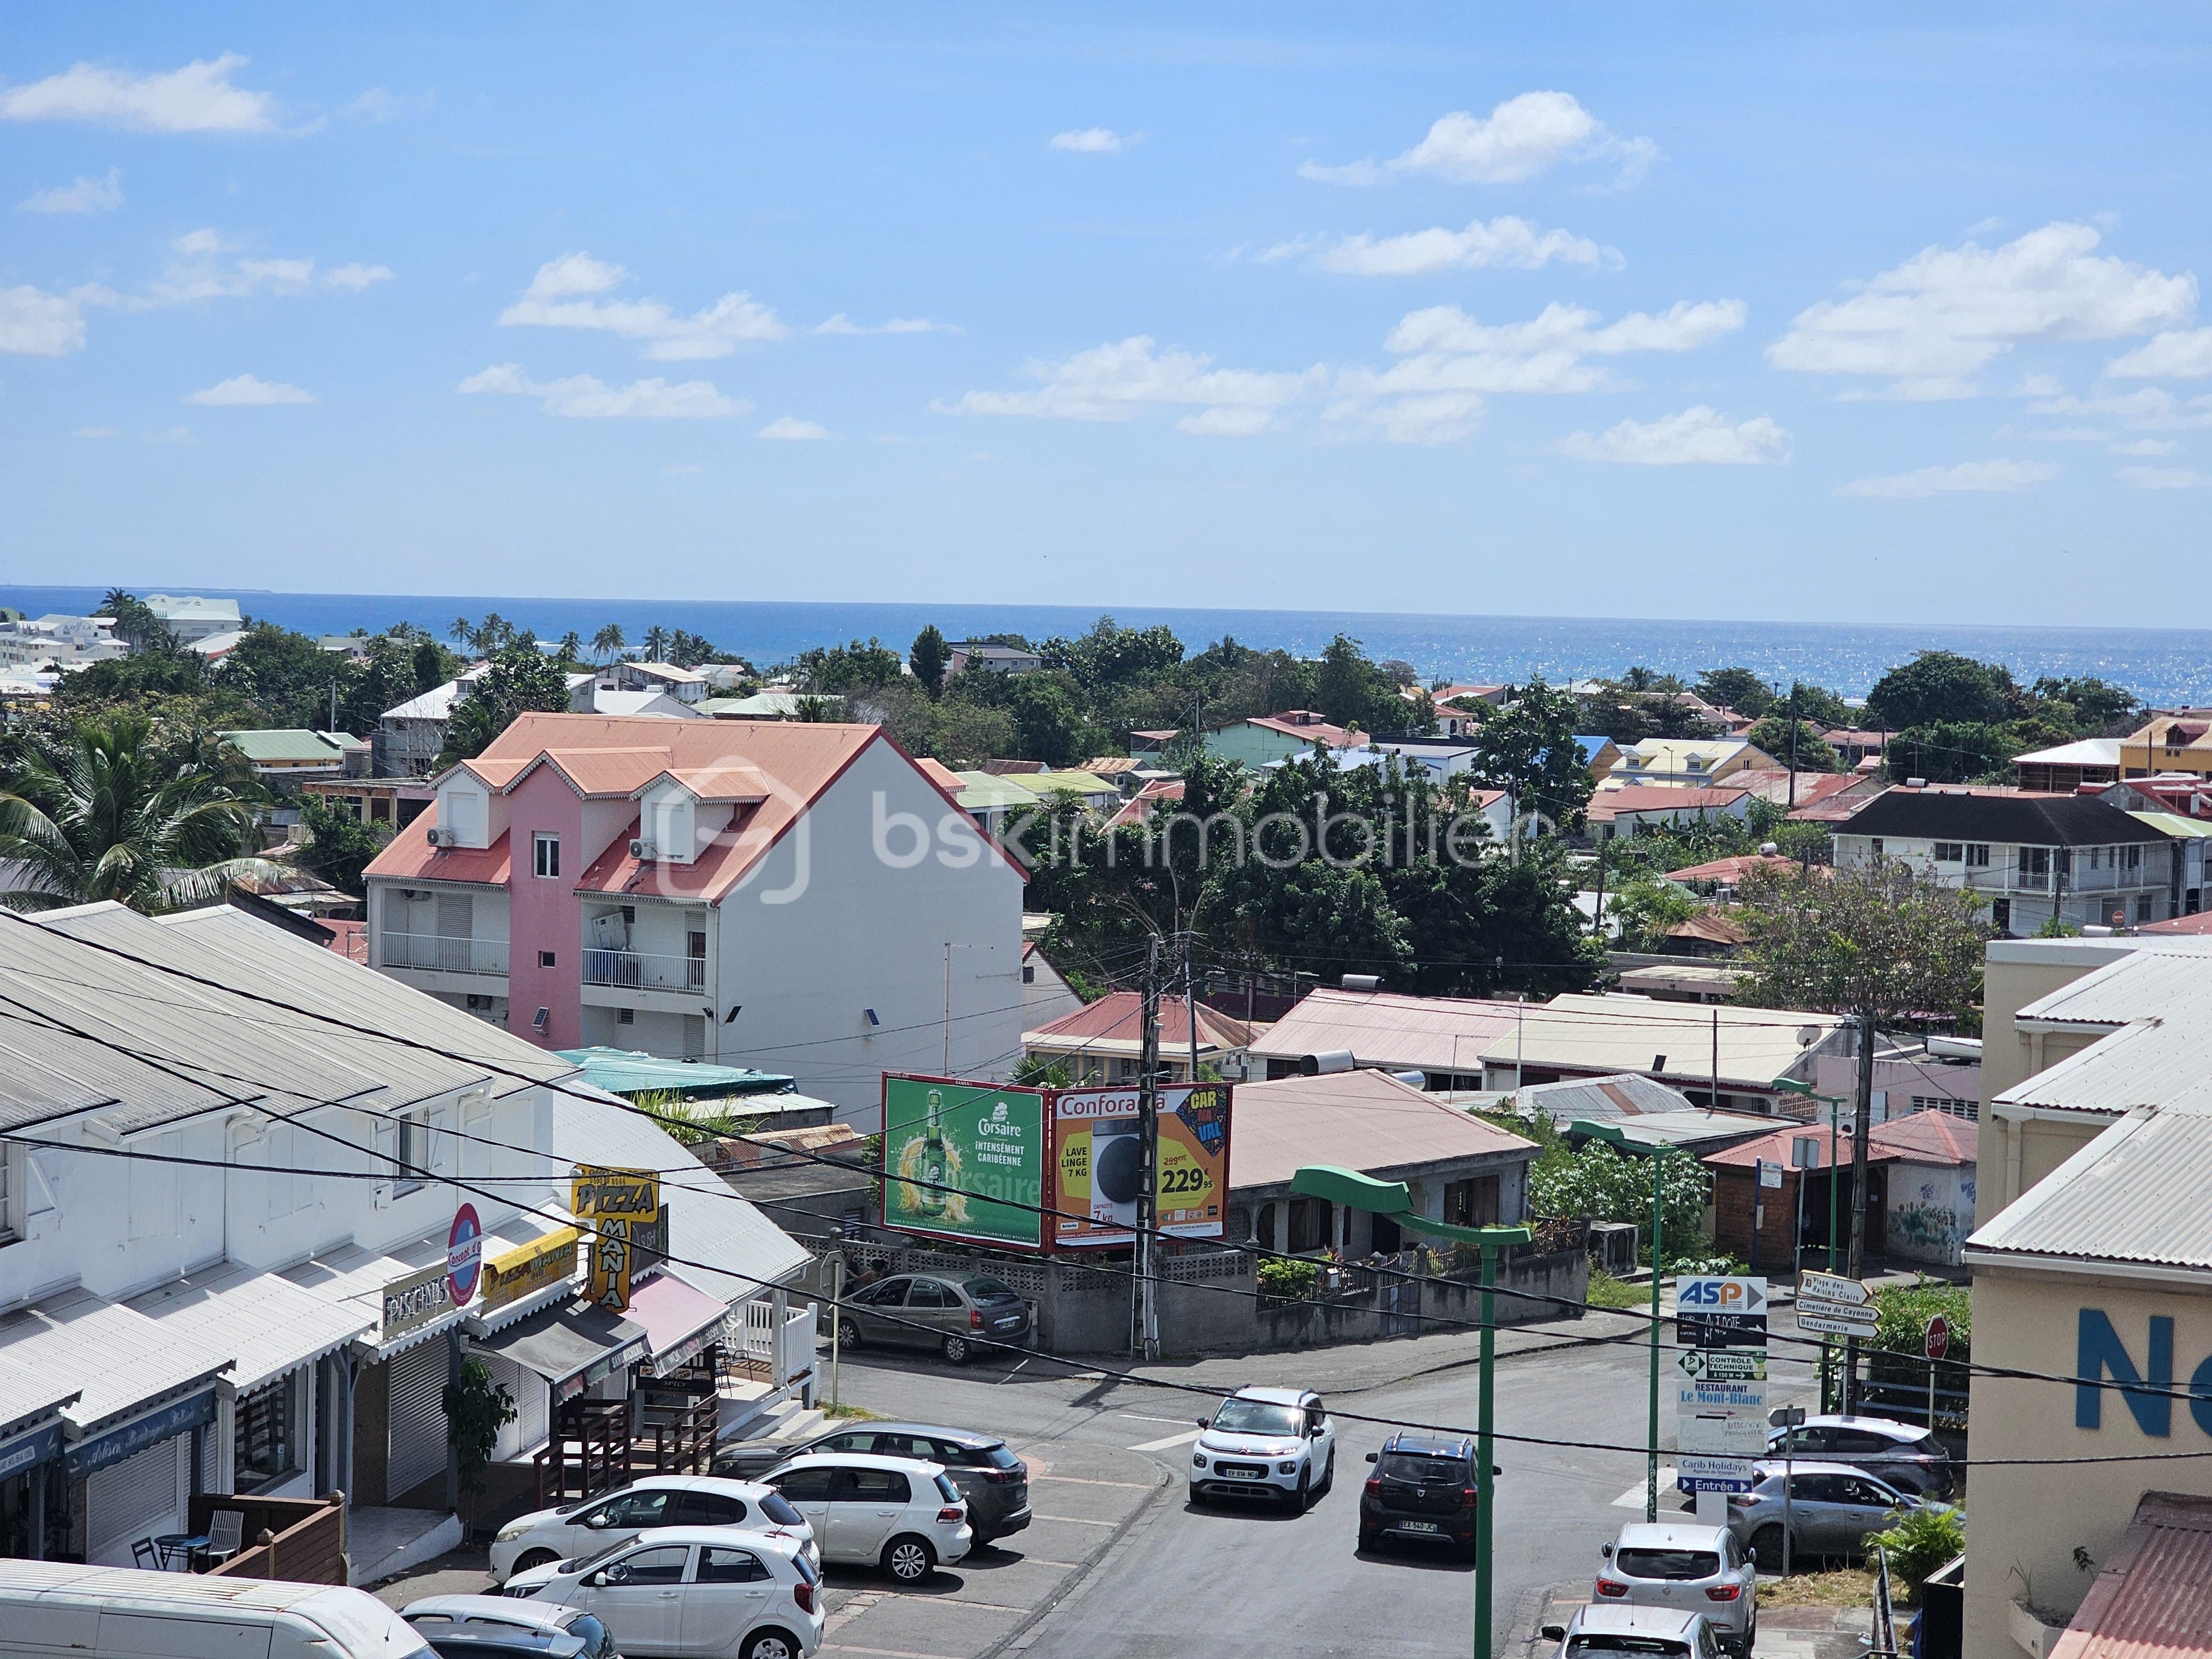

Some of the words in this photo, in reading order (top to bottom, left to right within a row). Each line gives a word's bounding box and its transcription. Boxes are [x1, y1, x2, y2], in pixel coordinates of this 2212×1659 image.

[1062, 1095, 1165, 1115] Conforaa
[1191, 1091, 1217, 1109] CAR
[978, 1118, 1021, 1137] Corsaire
[1198, 1121, 1222, 1141] VAL
[975, 1141, 1025, 1155] INTENSÉMENT
[1066, 1147, 1087, 1156] LAVE
[978, 1152, 1022, 1166] CARIBÉENNE
[1061, 1158, 1087, 1168] LINGE
[1068, 1169, 1073, 1177] 7
[1076, 1168, 1087, 1177] KG
[1161, 1168, 1203, 1193] 229
[576, 1182, 655, 1215] PIZZA
[1094, 1211, 1101, 1220] 7
[448, 1249, 470, 1264] Concept
[472, 1241, 482, 1253] d'O
[530, 1242, 573, 1272] MANIA
[598, 1218, 627, 1309] MANIA
[1813, 1277, 1829, 1287] Plage
[1833, 1281, 1844, 1290] des
[384, 1275, 451, 1327] PISCINES
[1680, 1281, 1742, 1305] ASP
[1812, 1287, 1835, 1297] Raisins
[1839, 1291, 1859, 1301] Clairs
[1799, 1301, 1832, 1312] Cimetière
[1843, 1307, 1873, 1318] Cayenne
[1801, 1318, 1848, 1332] Gendarmerie
[1929, 1332, 1945, 1349] STOP
[1695, 1384, 1748, 1393] RESTAURANT
[1681, 1390, 1694, 1402] Le
[1698, 1391, 1763, 1406] Mont-Blanc
[1682, 1459, 1705, 1469] Carib
[1708, 1461, 1747, 1472] Holidays
[1695, 1479, 1733, 1491] Entrée
